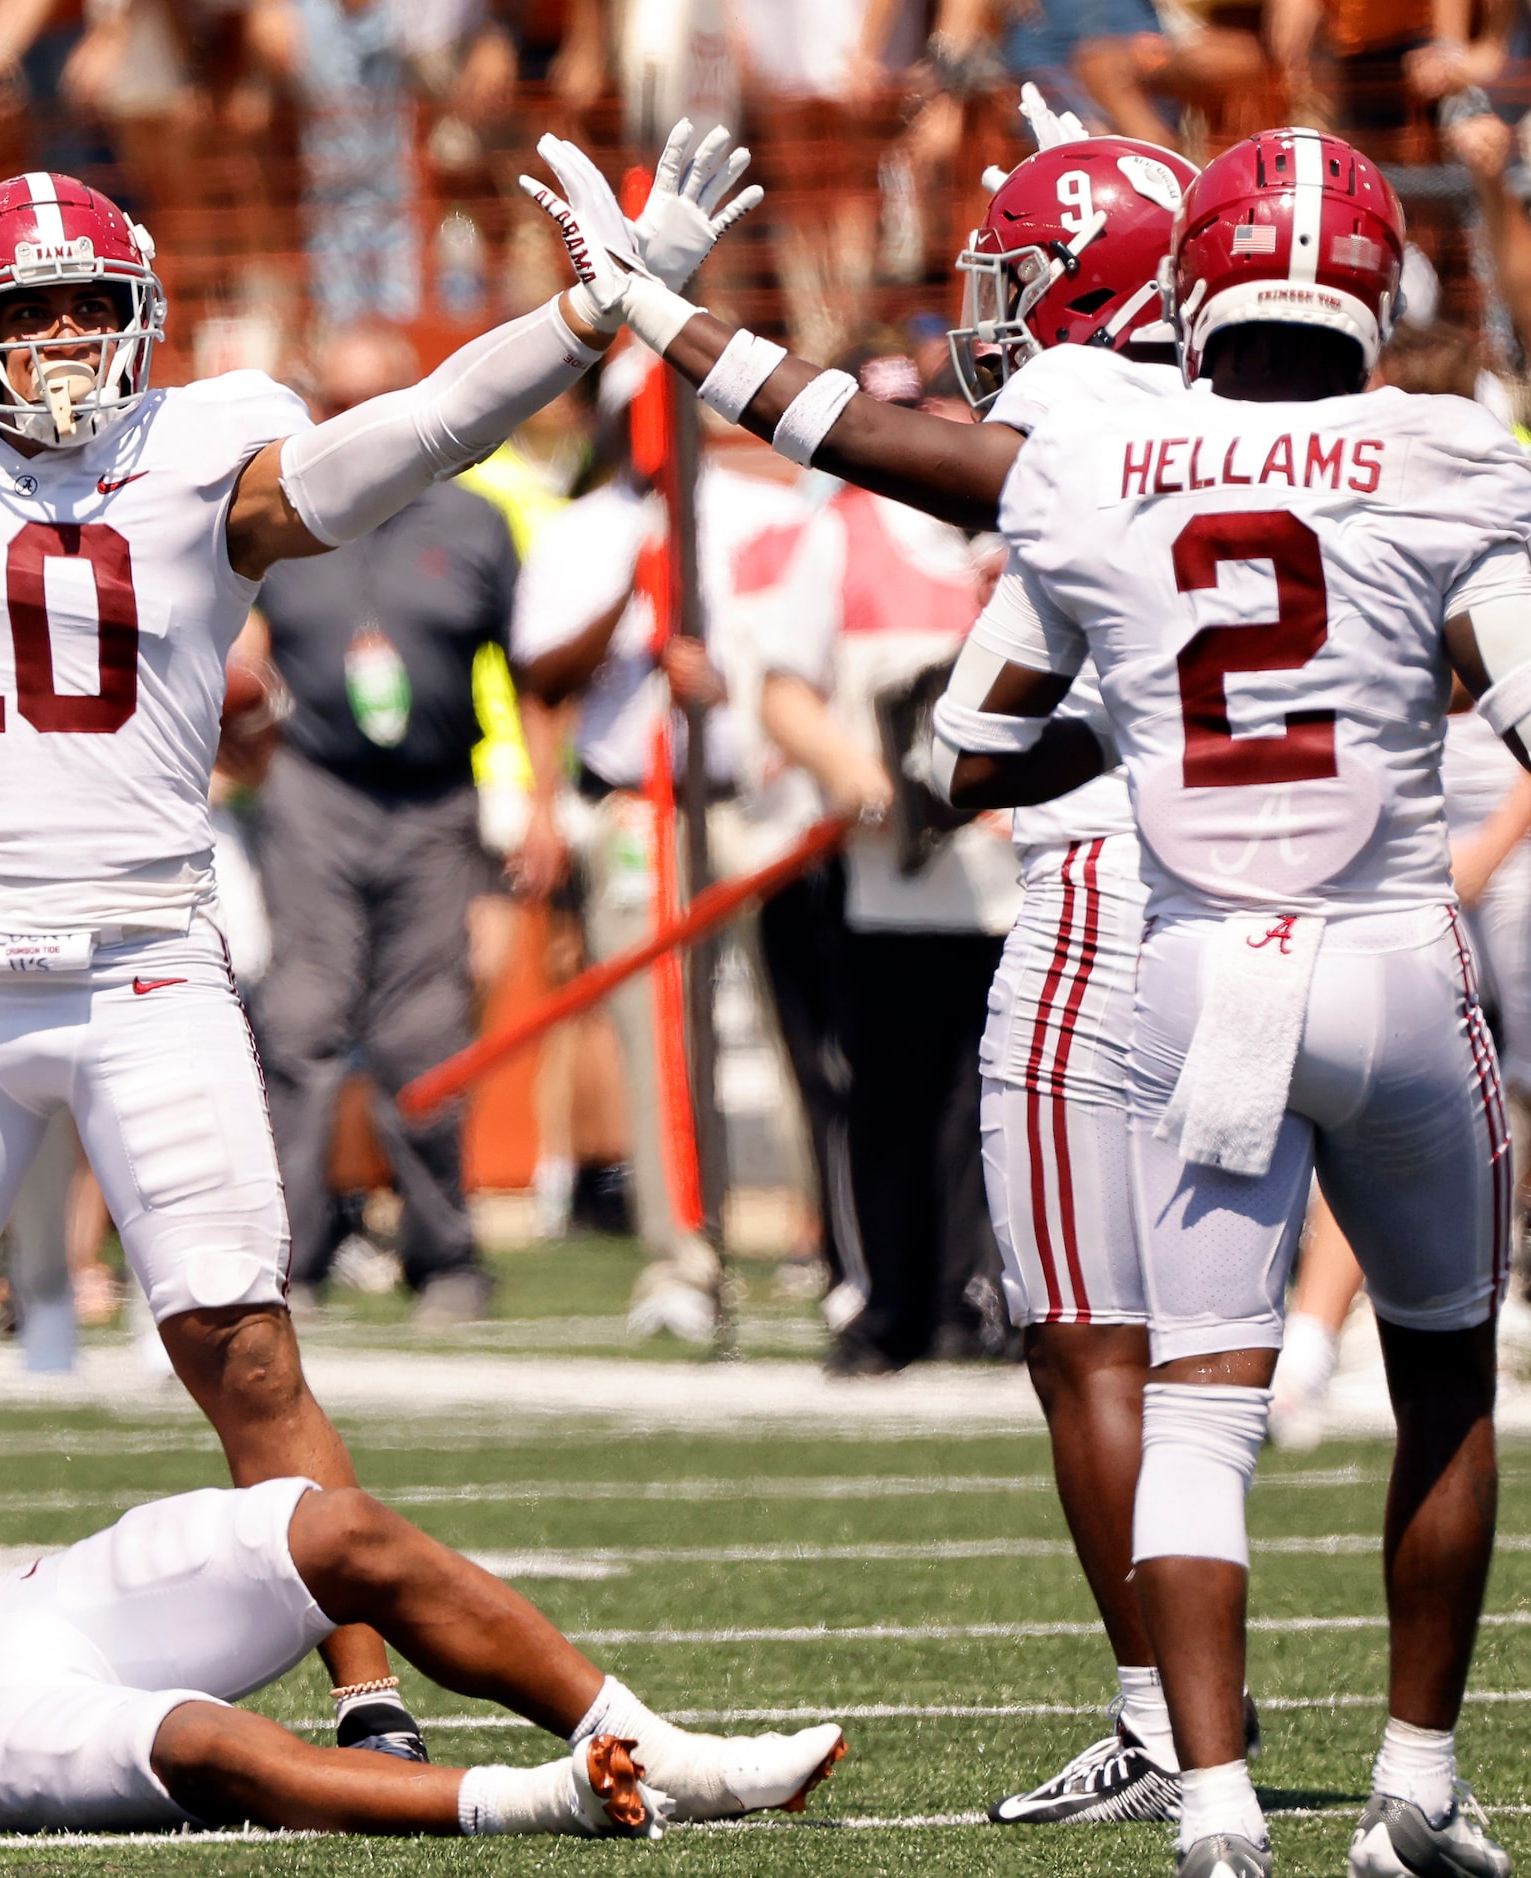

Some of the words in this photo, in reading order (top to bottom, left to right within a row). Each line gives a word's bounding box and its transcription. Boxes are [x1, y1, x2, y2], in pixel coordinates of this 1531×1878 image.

[1056, 170, 1093, 233] 9
[36, 246, 73, 260] BAMA
[534, 190, 596, 285] ALABAMA
[1122, 433, 1385, 498] HELLAMS
[1171, 509, 1338, 788] 2
[43, 946, 60, 954] TIDE
